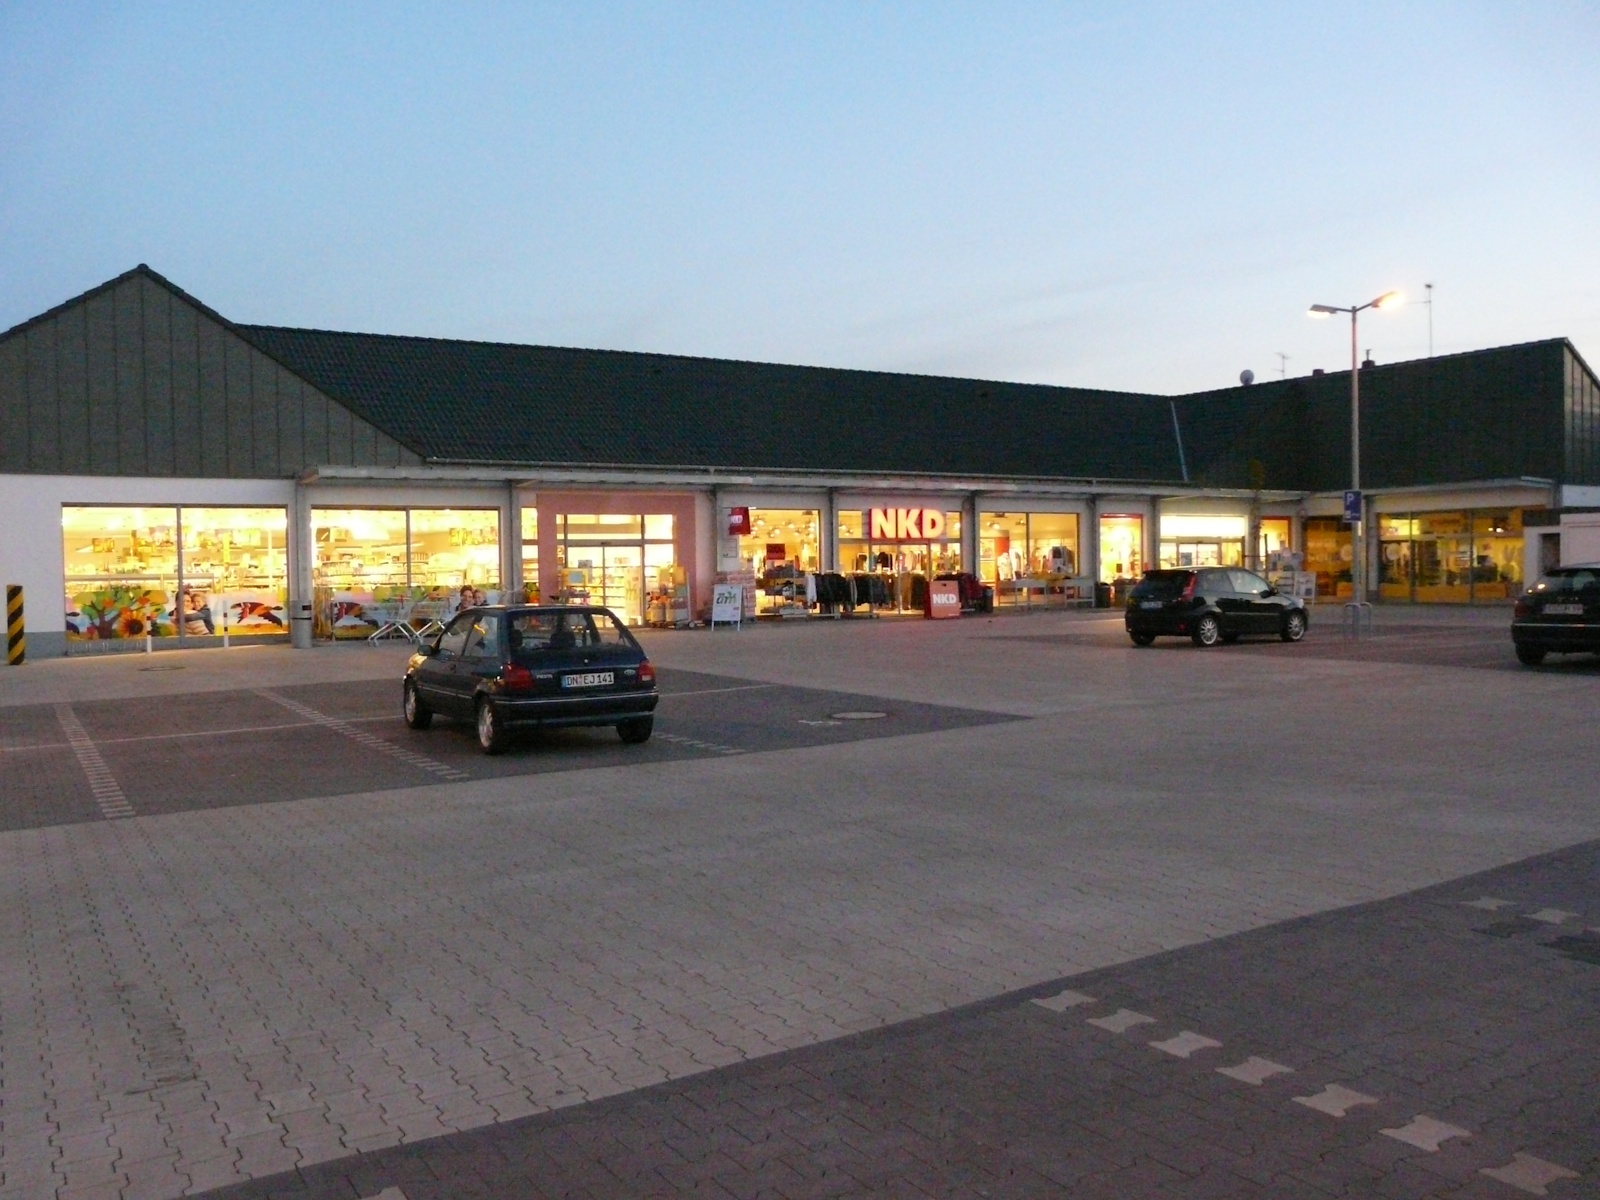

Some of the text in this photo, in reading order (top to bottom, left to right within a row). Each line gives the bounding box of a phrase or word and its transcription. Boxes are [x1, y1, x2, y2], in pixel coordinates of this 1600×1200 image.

[1346, 493, 1354, 505] P
[869, 508, 944, 539] NKD
[932, 593, 957, 604] NKD
[566, 673, 613, 686] DN EJ 141
